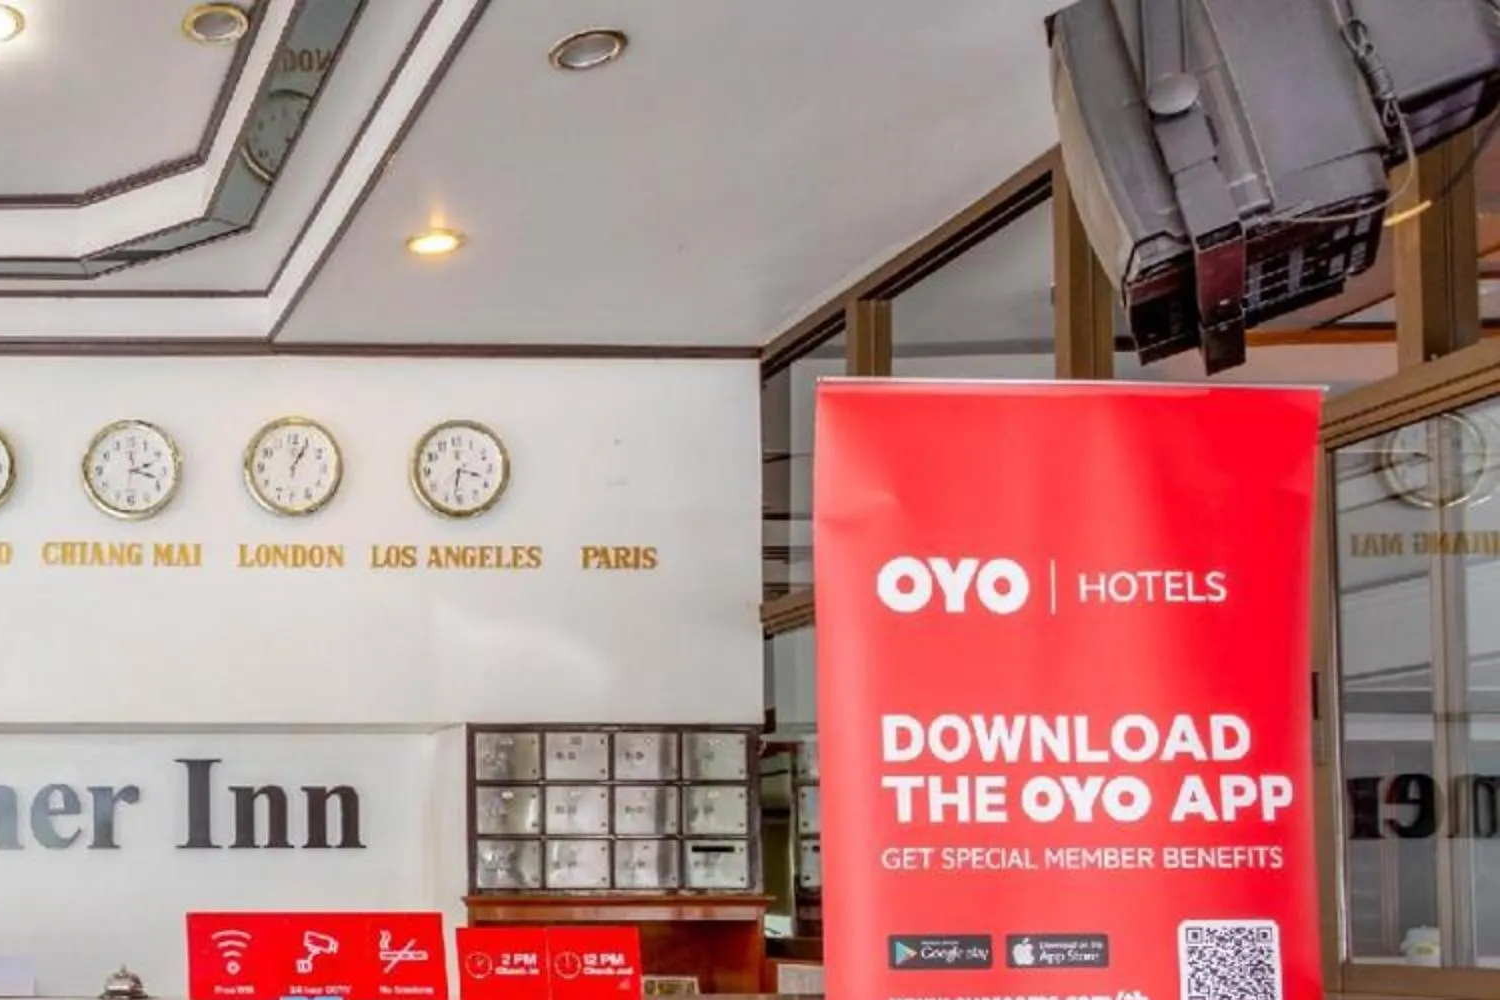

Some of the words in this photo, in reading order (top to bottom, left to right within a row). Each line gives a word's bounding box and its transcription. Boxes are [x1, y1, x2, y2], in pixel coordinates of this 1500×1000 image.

[41, 541, 143, 566] CHIANG
[153, 543, 201, 566] MAI
[237, 543, 344, 567] LONDON
[371, 545, 417, 568] LOS
[426, 545, 542, 569] ANGELES
[581, 546, 658, 569] PARIS
[876, 556, 1030, 614] OYO
[1078, 570, 1228, 603] HOTELS
[881, 714, 1251, 763] DOWNLOAD
[174, 758, 367, 850] Inn
[881, 775, 1008, 823] THE
[1021, 775, 1152, 822] OYO
[1170, 774, 1293, 823] APP
[881, 848, 934, 871] GET
[941, 848, 1037, 870] SPECIAL
[1044, 848, 1155, 869] MEMBER
[1163, 846, 1284, 870] BENEFITS
